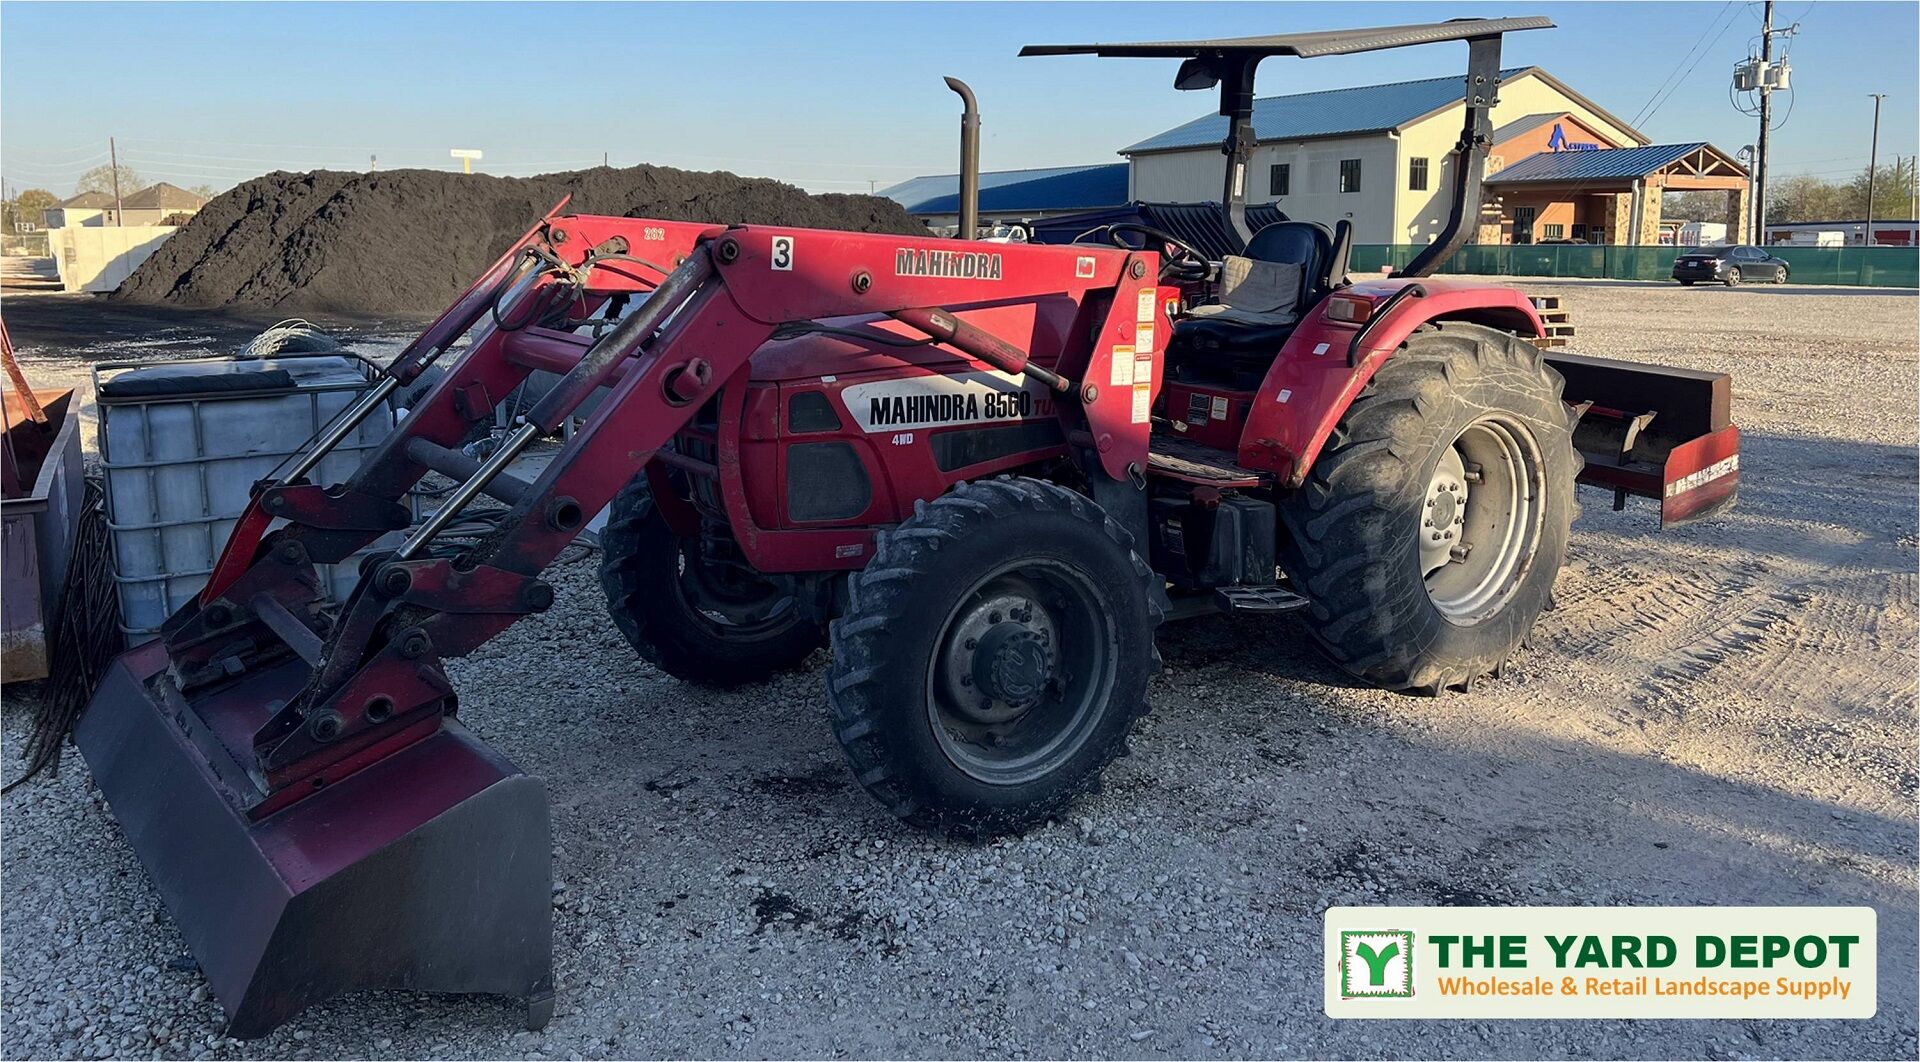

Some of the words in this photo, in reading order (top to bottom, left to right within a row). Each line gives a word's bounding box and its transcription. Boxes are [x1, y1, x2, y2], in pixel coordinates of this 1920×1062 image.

[774, 238, 791, 268] 3
[895, 247, 1002, 280] MAHINDRA
[870, 393, 979, 425] MAHINDRA
[984, 391, 1031, 419] 8560
[891, 432, 914, 446] 4WD
